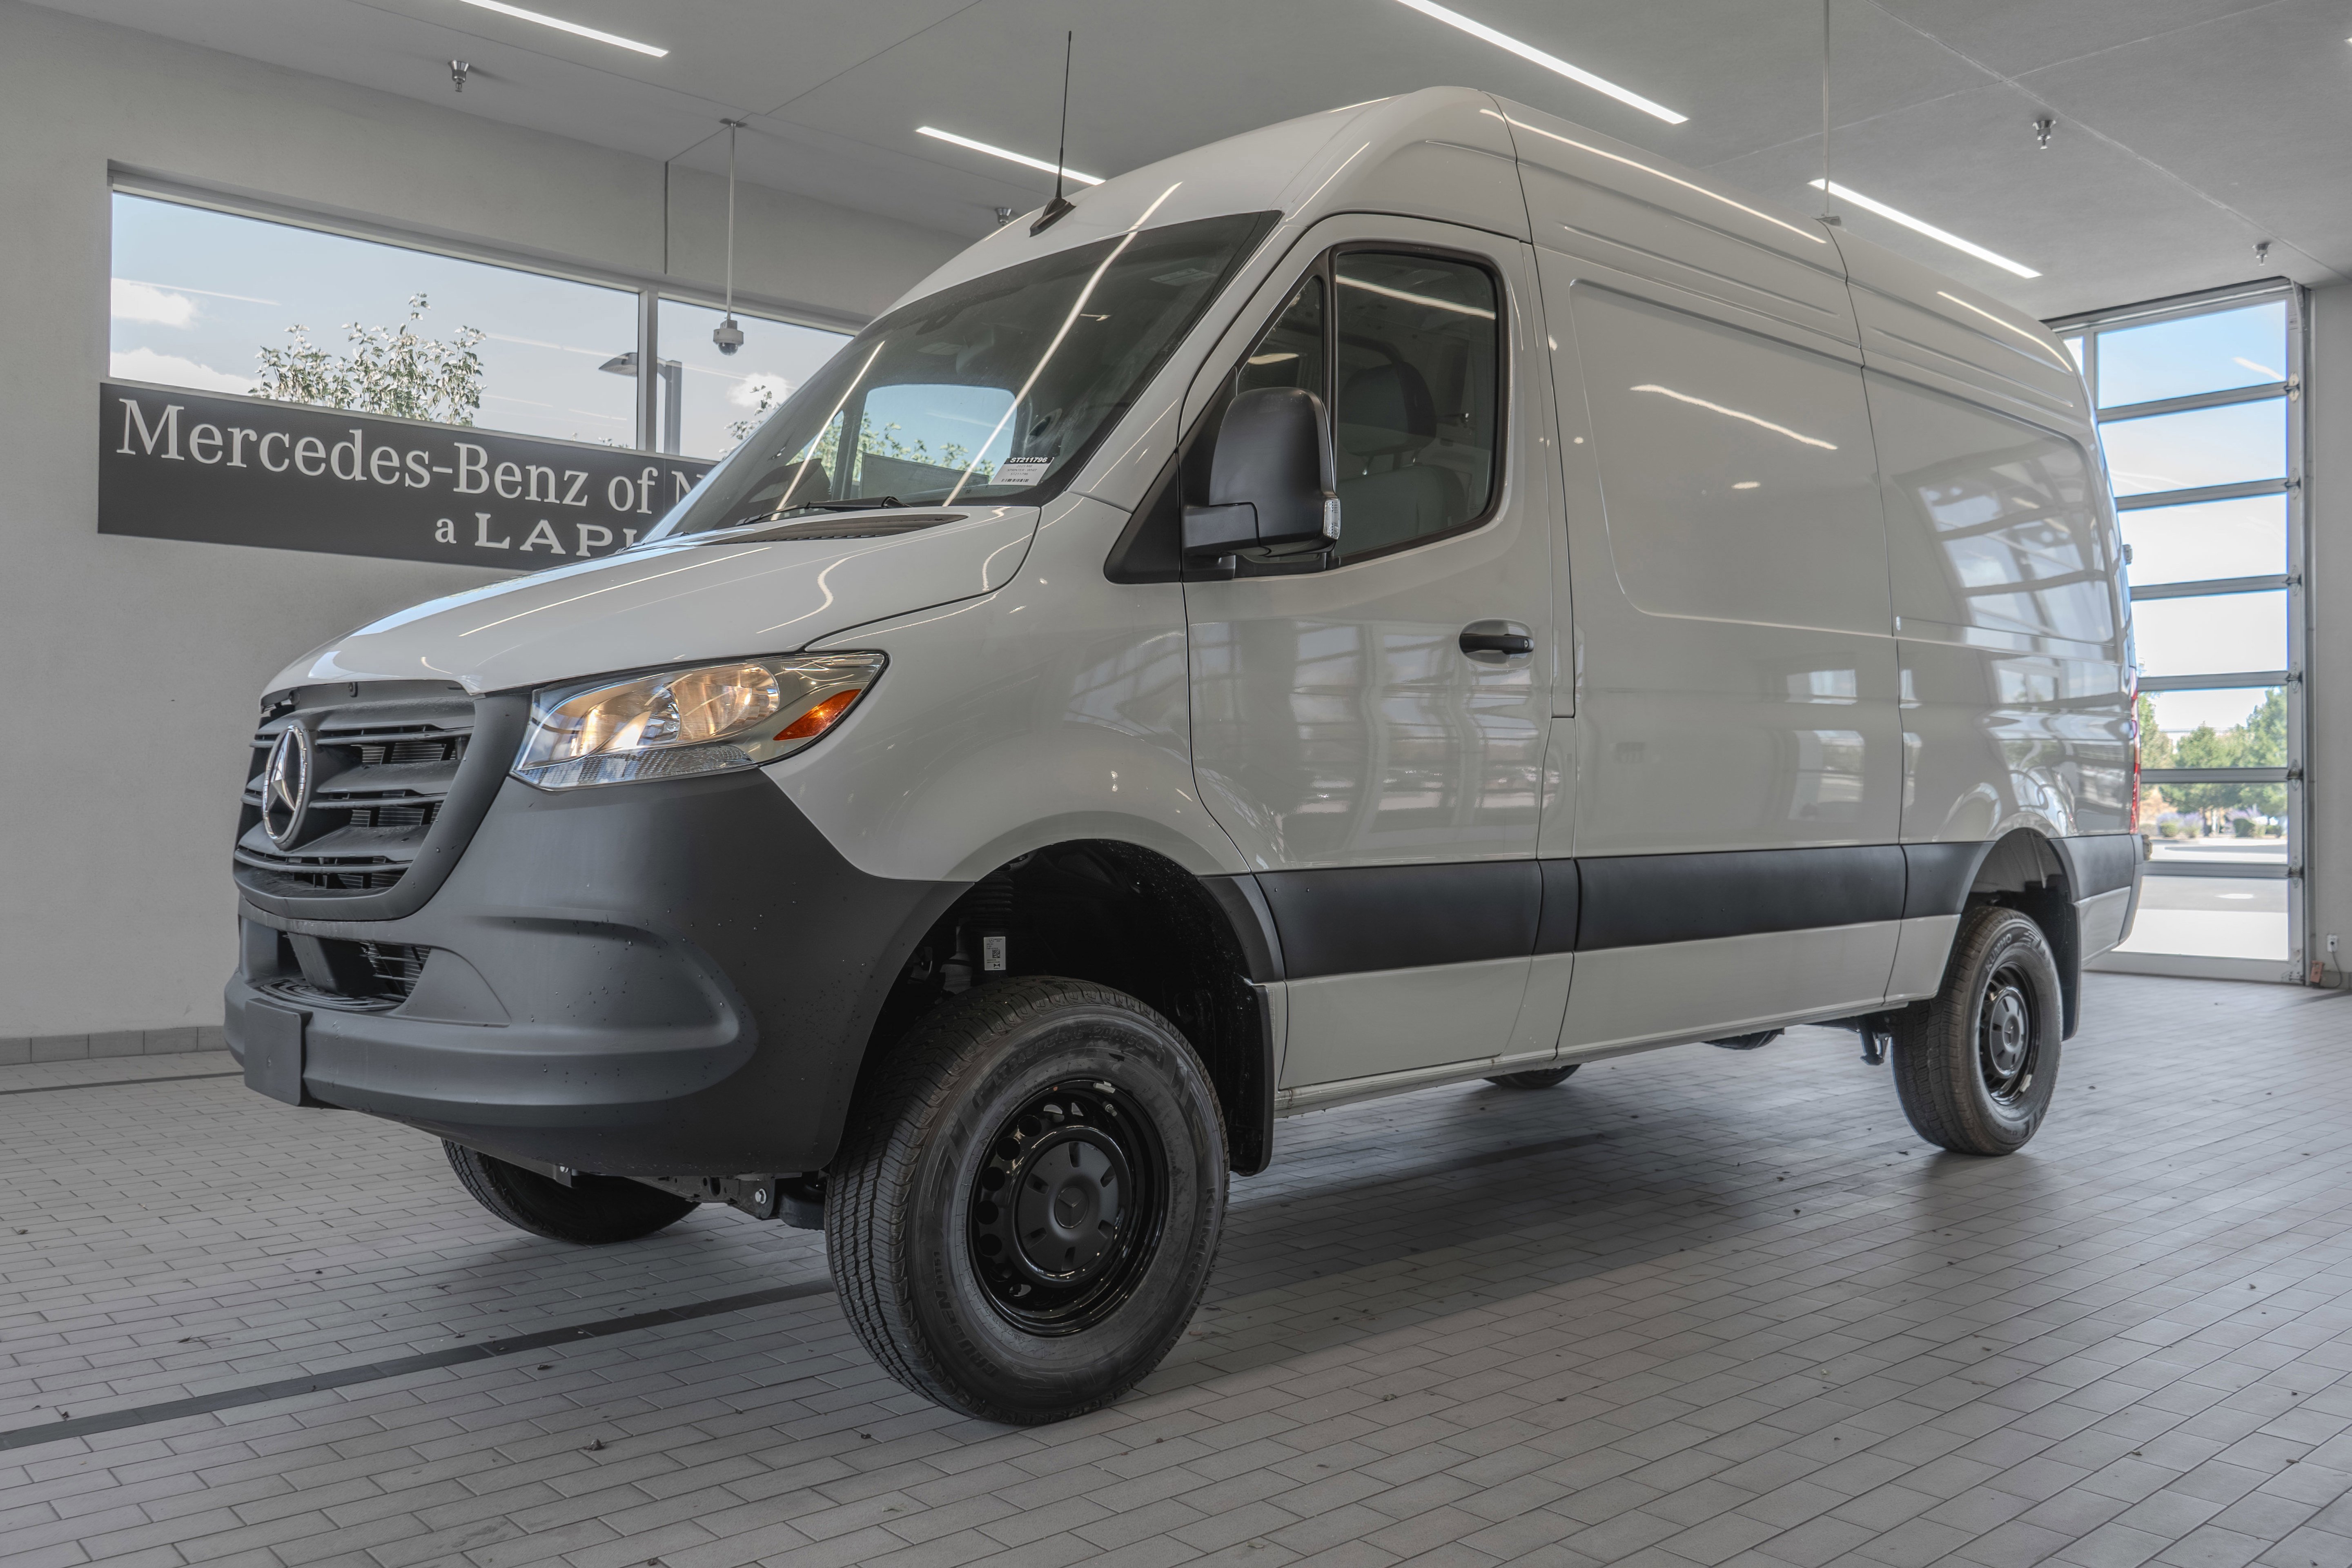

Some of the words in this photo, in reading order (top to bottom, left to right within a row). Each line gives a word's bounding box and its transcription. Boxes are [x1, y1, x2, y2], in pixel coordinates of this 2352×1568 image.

[116, 398, 588, 507] Mercedes-Benz
[608, 466, 658, 514] of
[435, 518, 457, 543] a
[1985, 933, 2012, 972] KUMHO
[1185, 1187, 1216, 1286] KUMHO
